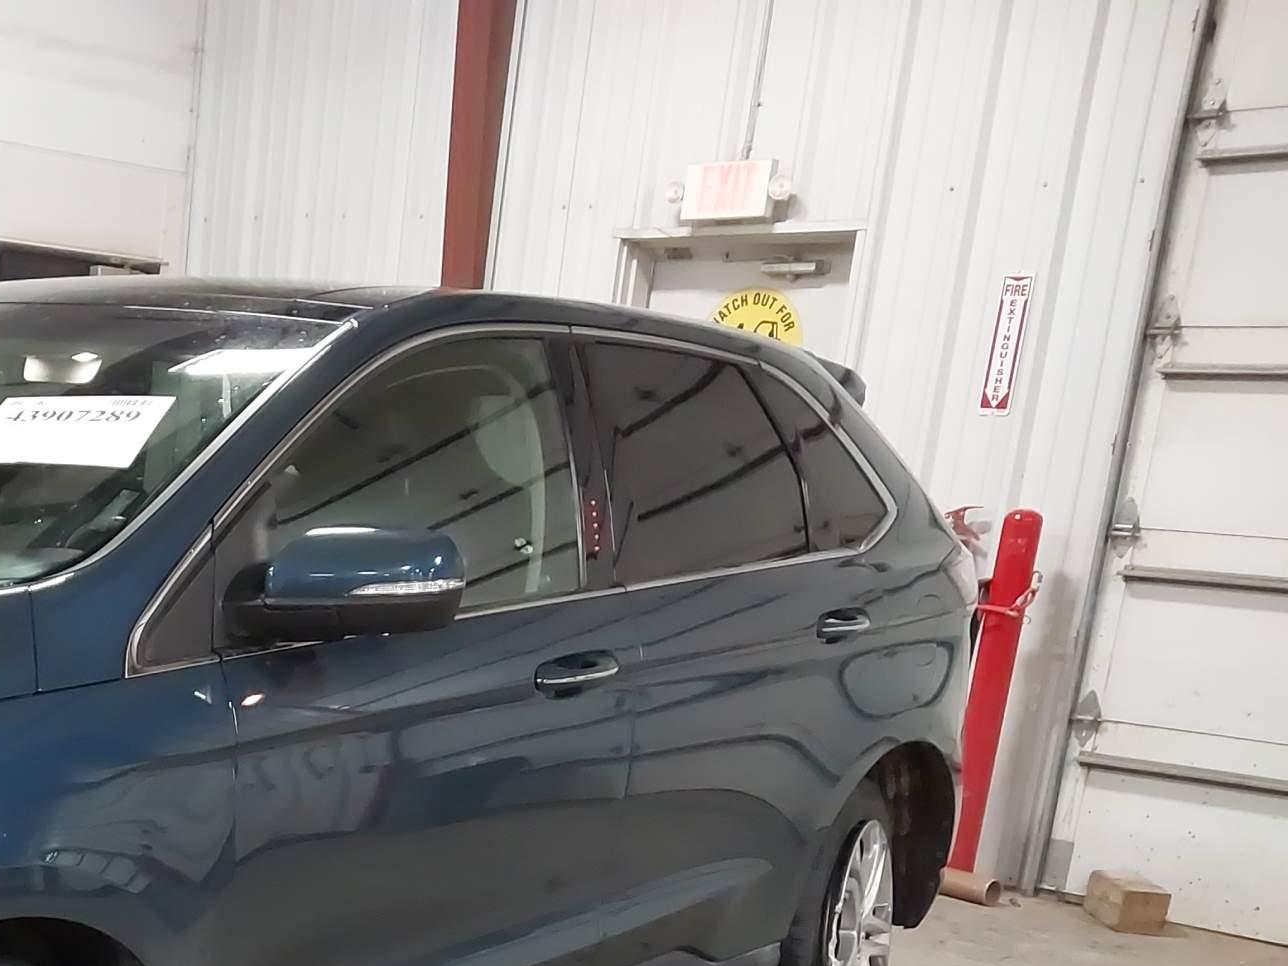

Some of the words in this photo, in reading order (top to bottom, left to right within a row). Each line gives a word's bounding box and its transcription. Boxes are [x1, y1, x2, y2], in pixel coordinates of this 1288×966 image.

[1004, 284, 1028, 297] FIRE
[753, 292, 778, 310] OUT
[775, 304, 795, 332] FOR
[991, 299, 1018, 401] EXTINGUISHER
[7, 410, 142, 423] 43907289
